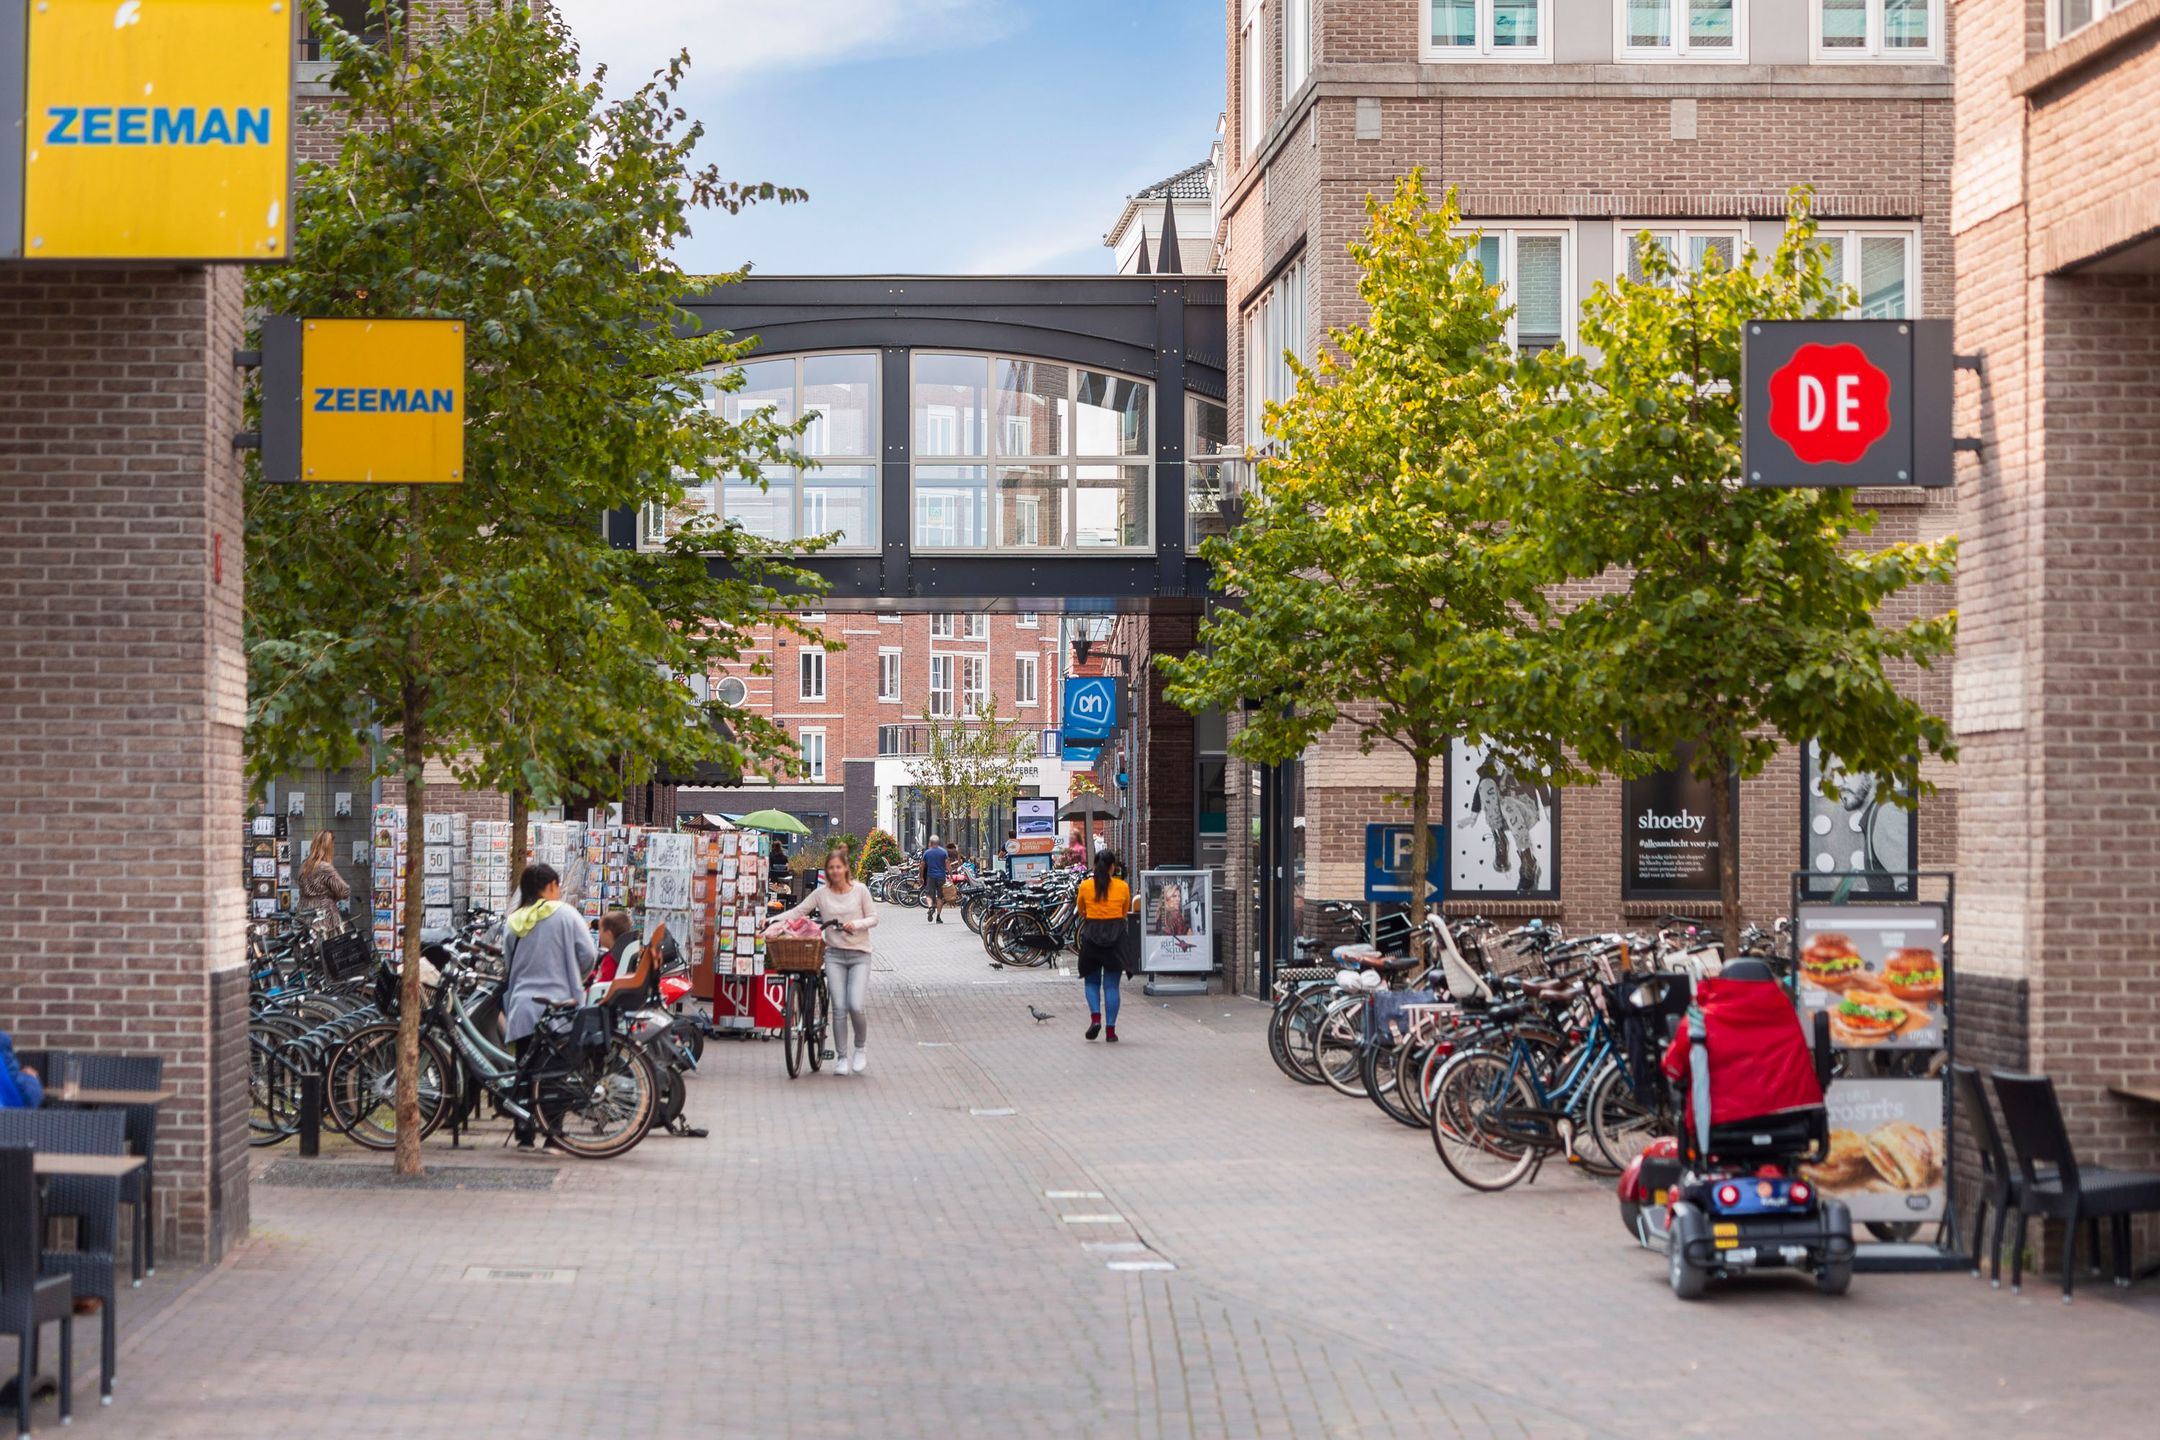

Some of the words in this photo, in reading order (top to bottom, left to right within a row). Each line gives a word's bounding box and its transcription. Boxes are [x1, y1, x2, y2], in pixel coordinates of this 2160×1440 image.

[47, 107, 270, 145] ZEEMAN
[314, 388, 453, 412] ZEEMAN
[1798, 375, 1860, 431] DE
[429, 822, 443, 836] 40
[1638, 808, 1706, 834] shoeby
[430, 853, 443, 867] 50
[1166, 945, 1192, 956] squd
